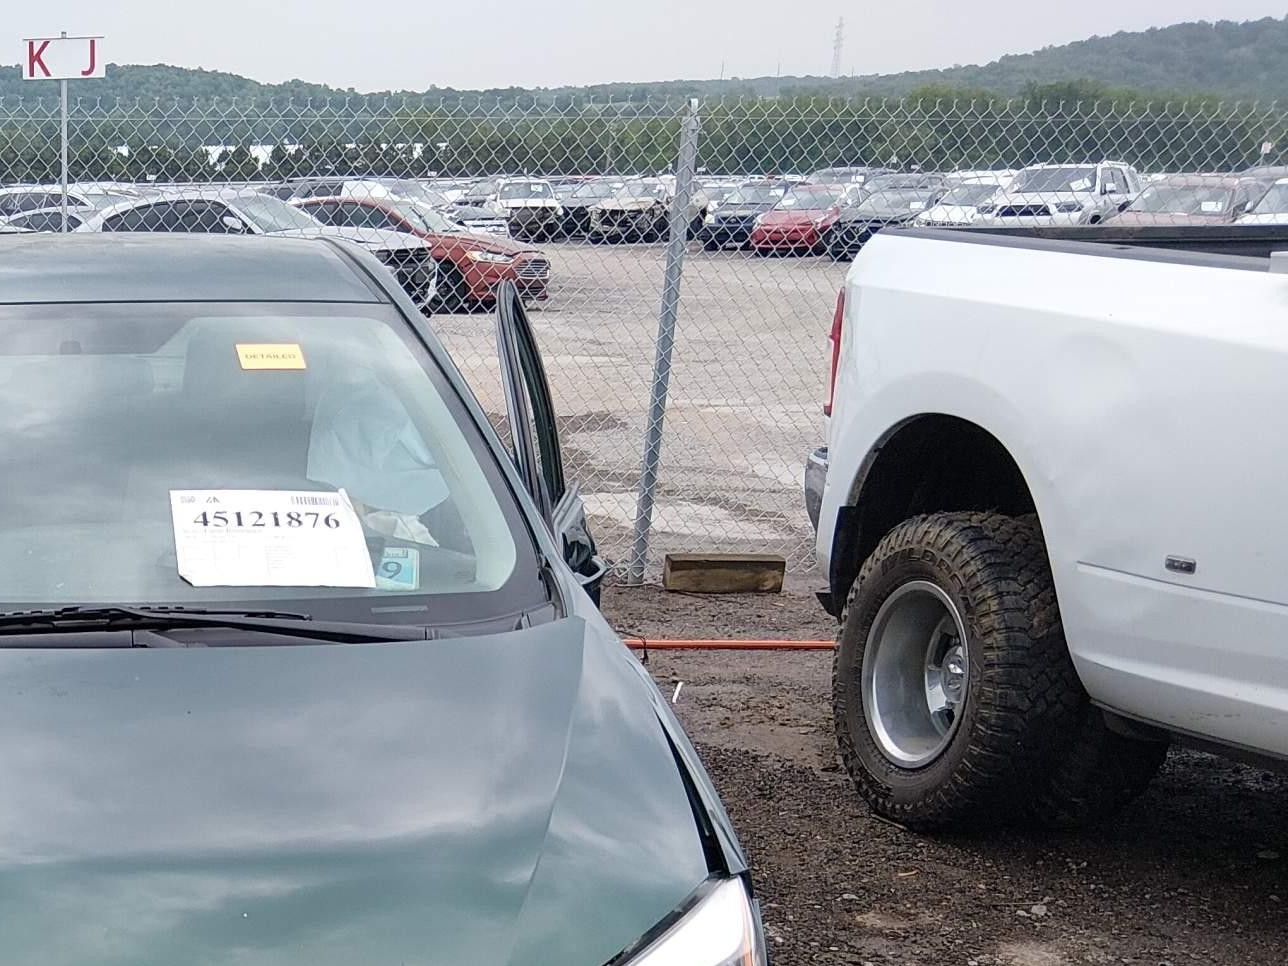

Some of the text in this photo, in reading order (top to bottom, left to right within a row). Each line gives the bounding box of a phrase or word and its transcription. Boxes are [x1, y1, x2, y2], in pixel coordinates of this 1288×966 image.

[28, 39, 95, 77] K J
[193, 511, 340, 529] 45121876
